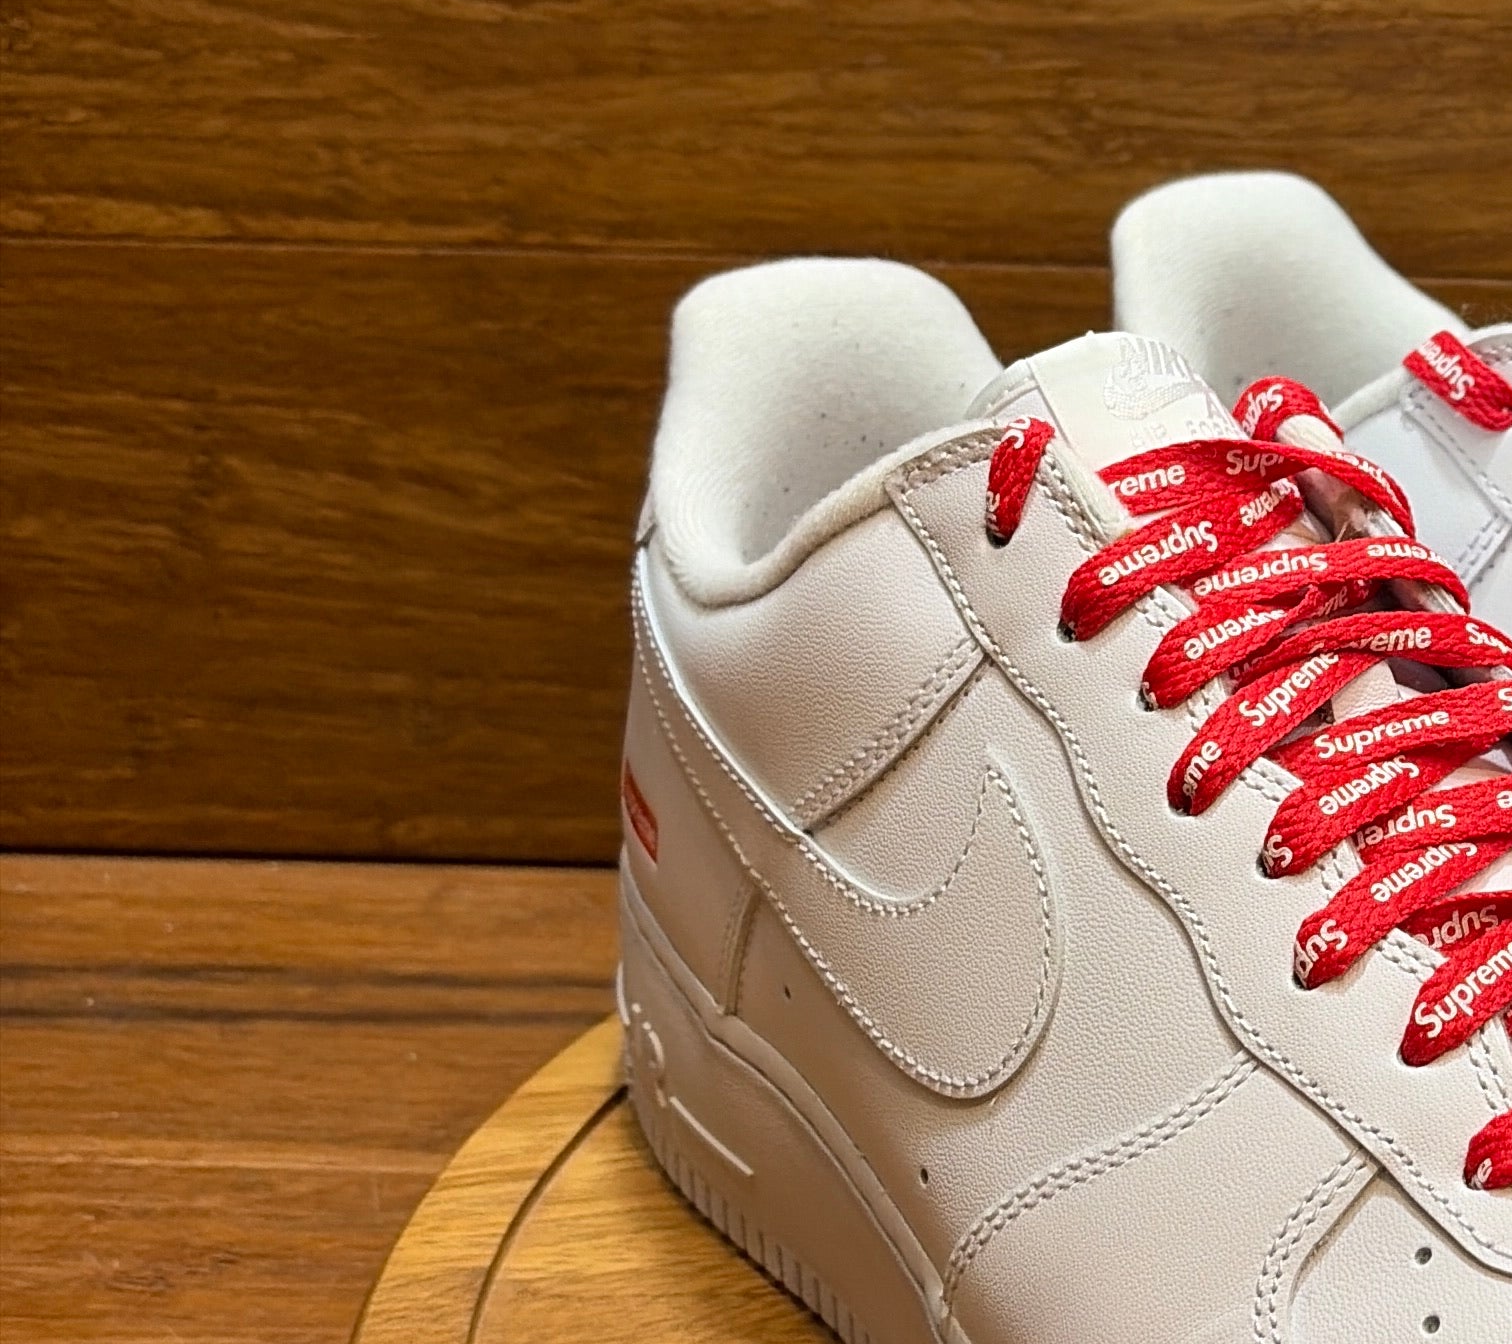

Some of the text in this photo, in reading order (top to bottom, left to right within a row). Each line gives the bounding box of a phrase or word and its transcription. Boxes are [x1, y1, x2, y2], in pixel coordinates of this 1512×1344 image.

[1098, 520, 1219, 586] Supreme
[1194, 551, 1329, 598] Supreme
[1183, 608, 1288, 660] Supreme
[1238, 652, 1340, 728] Supreme
[1313, 711, 1451, 759] Supreme
[1318, 755, 1420, 816] Supreme
[1369, 843, 1478, 903] Supreme
